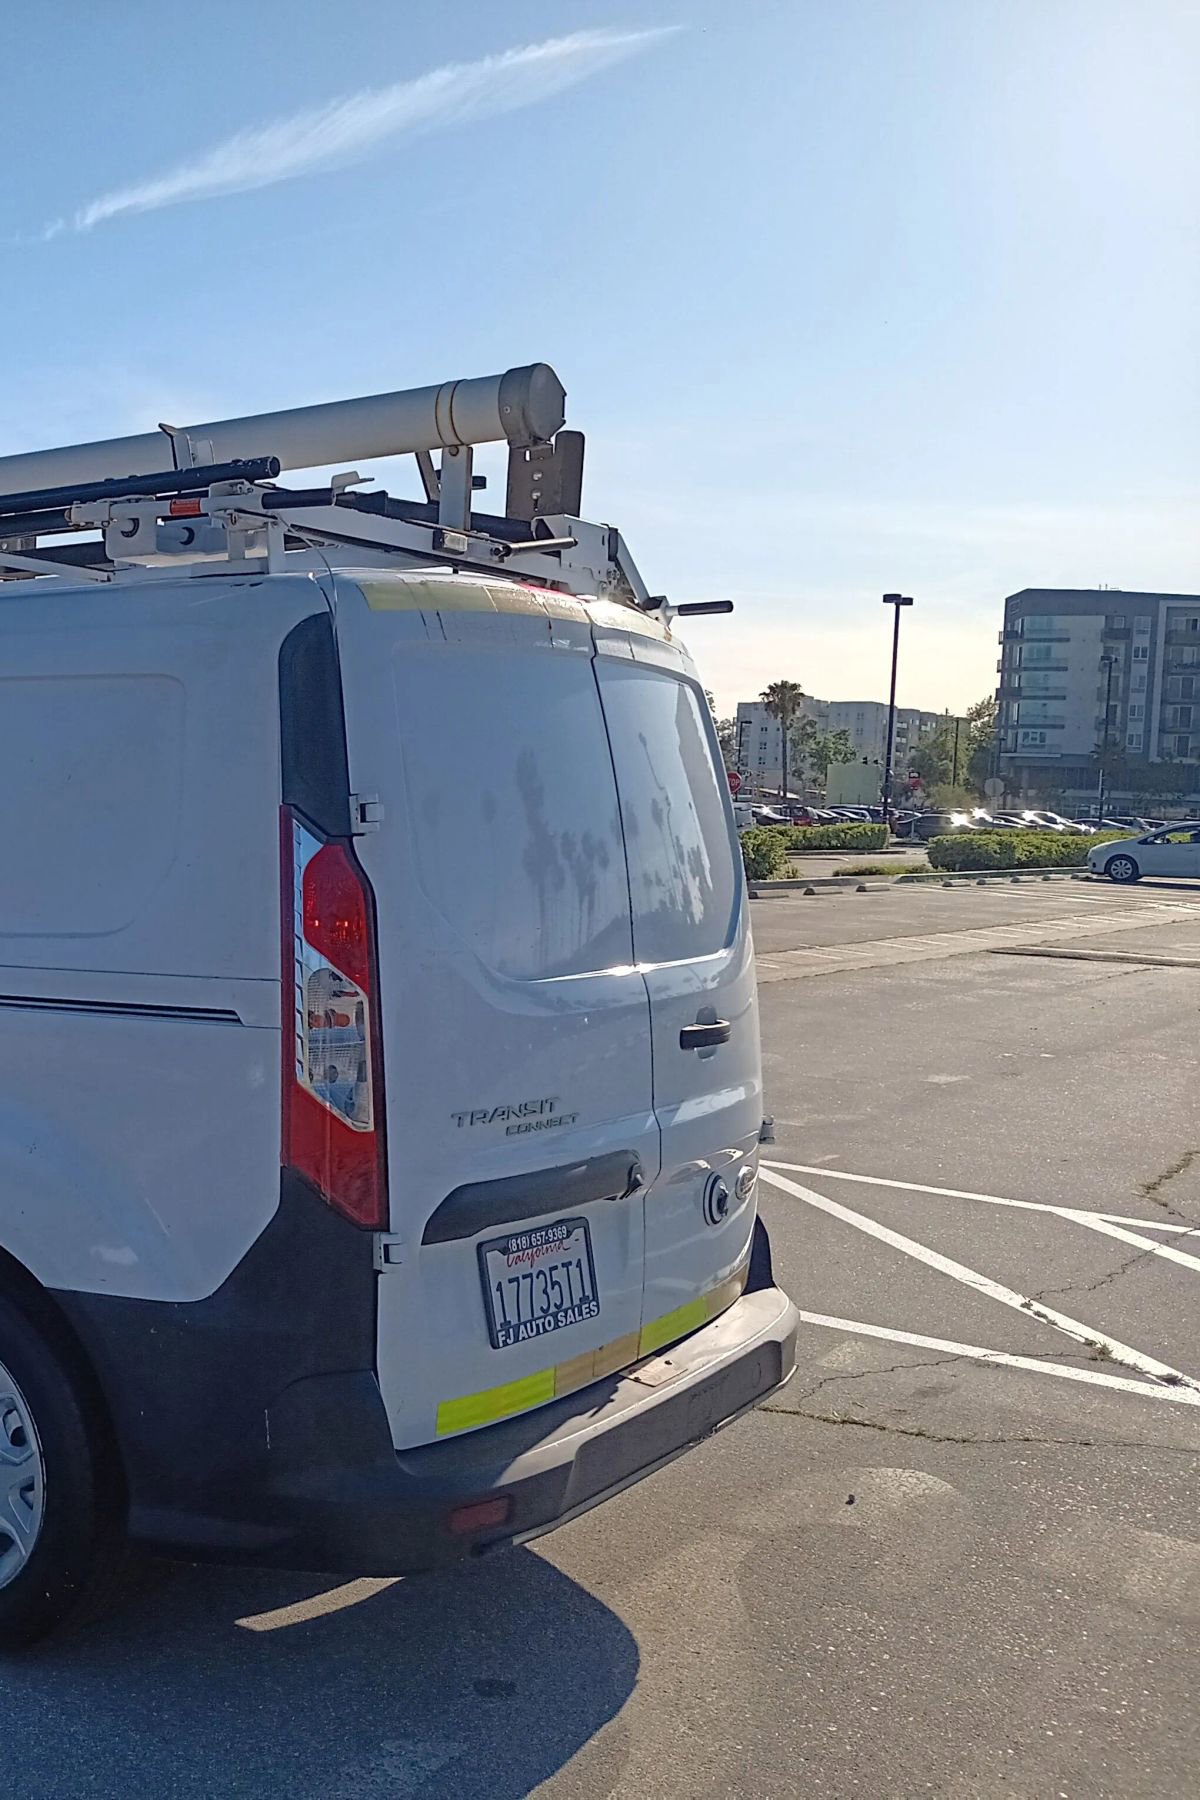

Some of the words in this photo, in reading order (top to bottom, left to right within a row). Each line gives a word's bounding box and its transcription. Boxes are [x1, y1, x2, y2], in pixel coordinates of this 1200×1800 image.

[450, 1096, 560, 1128] TRANSIT
[505, 1112, 579, 1136] CONNECT
[508, 1236, 530, 1252] (818)
[531, 1225, 567, 1248] 657-9369
[506, 1240, 571, 1269] California
[495, 1258, 590, 1329] 17735T1
[497, 1328, 514, 1348] FJ
[518, 1315, 555, 1341] AUTO
[557, 1301, 599, 1327] SALES
